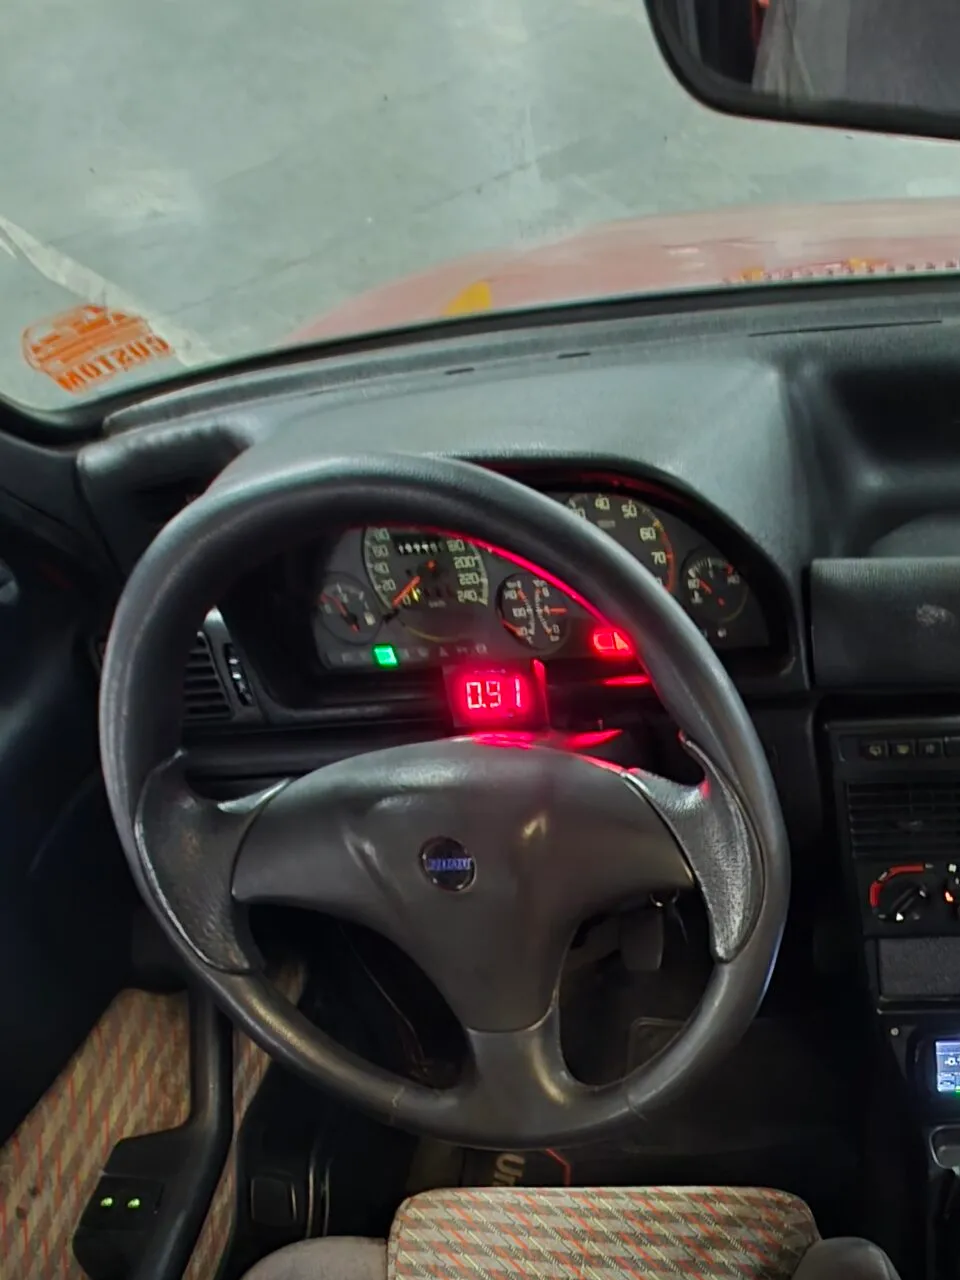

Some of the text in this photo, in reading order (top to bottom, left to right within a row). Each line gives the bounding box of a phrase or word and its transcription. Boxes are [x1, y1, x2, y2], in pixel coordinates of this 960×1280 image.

[595, 496, 611, 511] 40
[621, 504, 638, 519] 50
[639, 526, 656, 542] 60
[453, 556, 475, 569] 200
[651, 551, 666, 565] 70
[458, 572, 480, 586] 220
[457, 588, 478, 603] 240
[466, 678, 522, 709] 0.91
